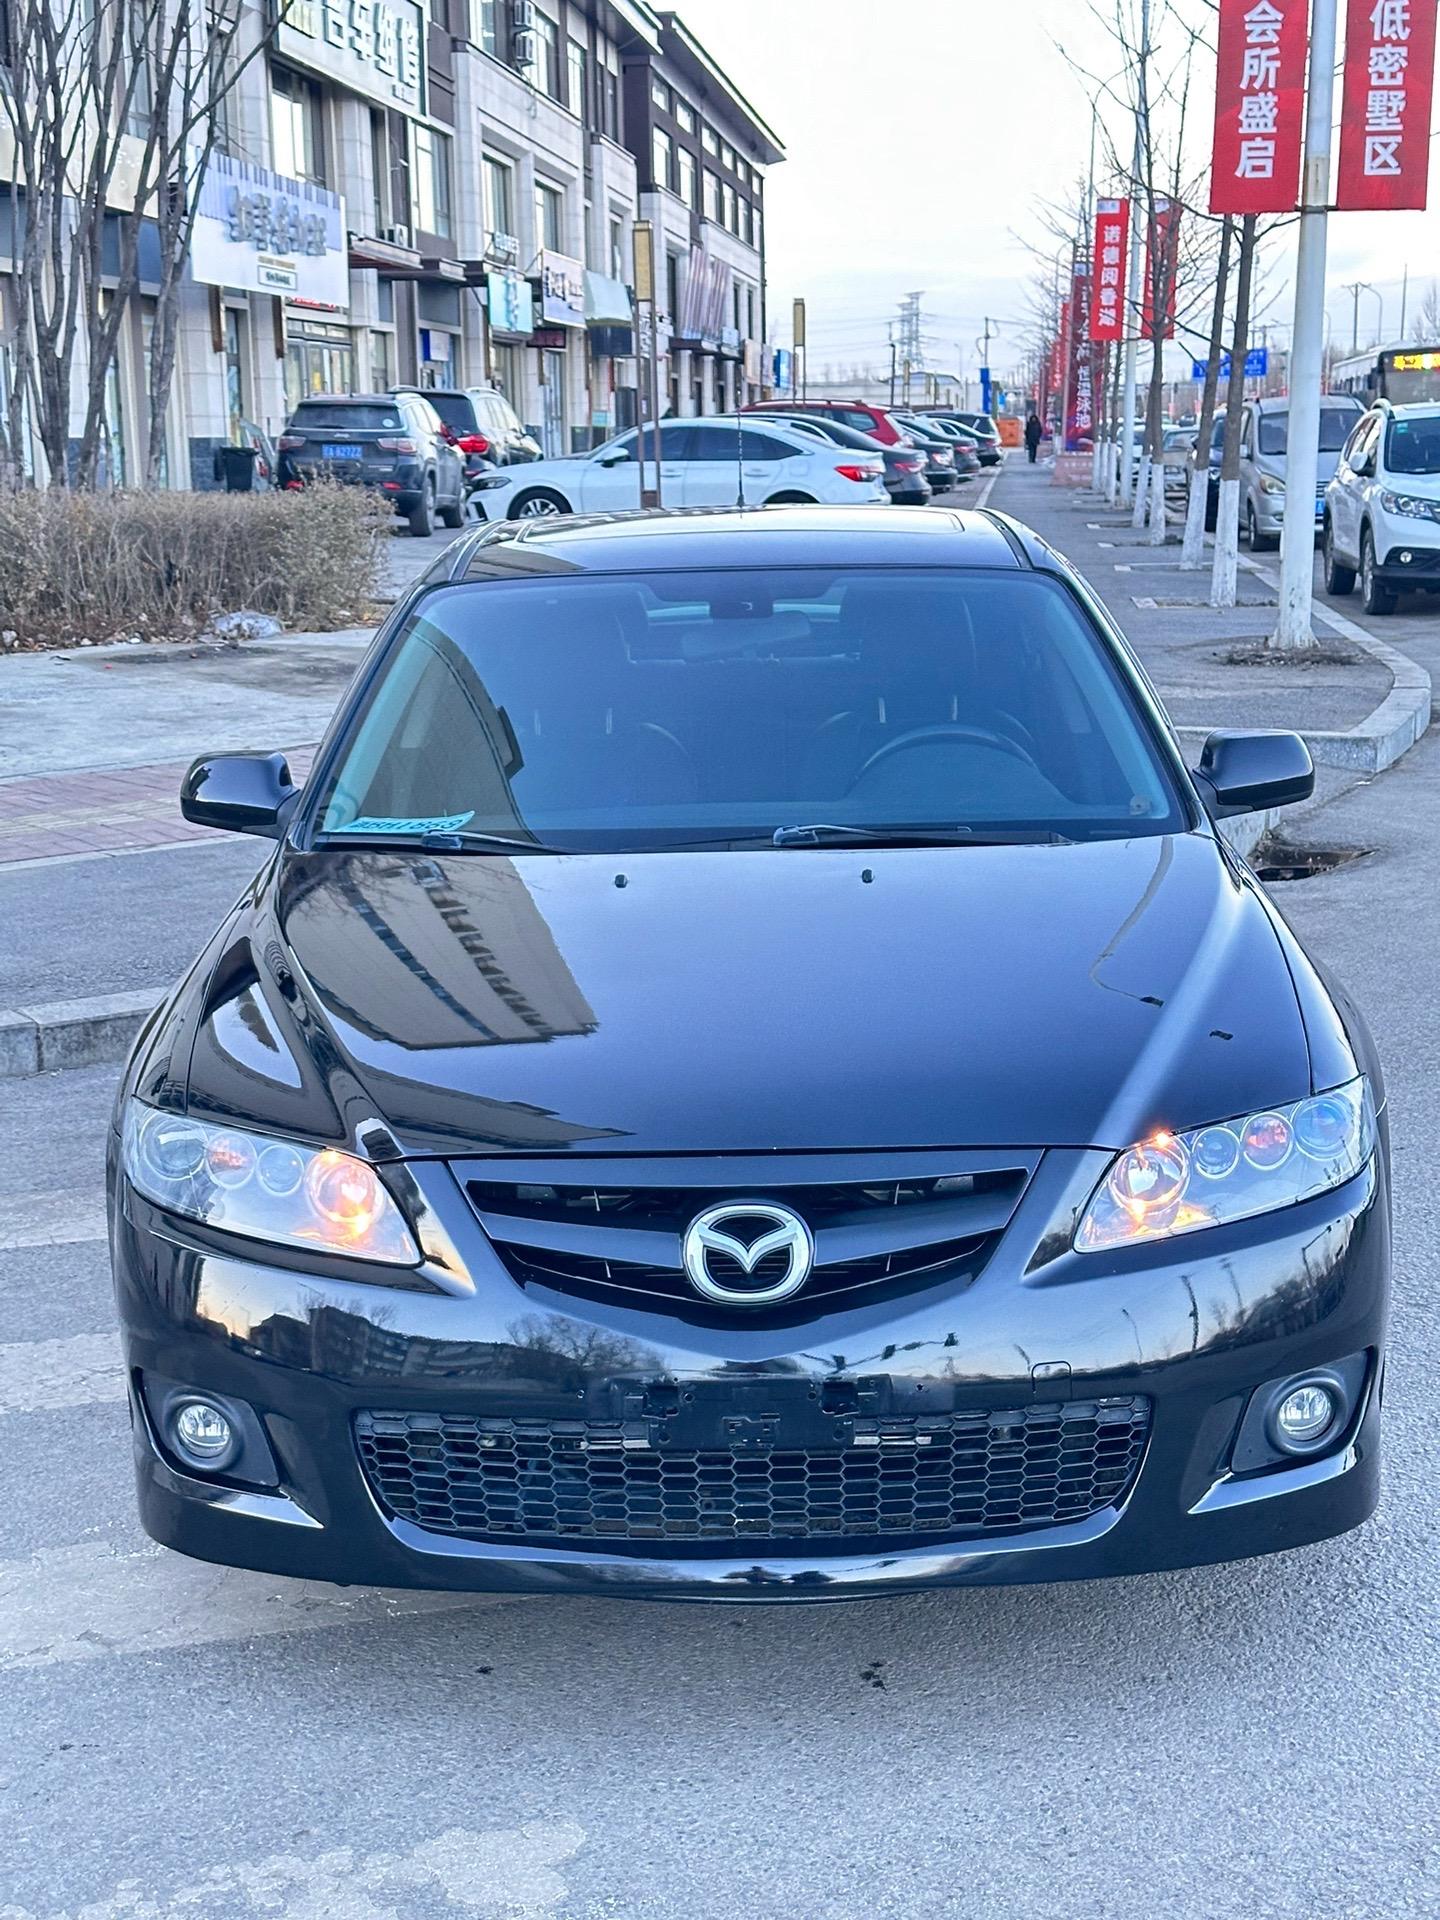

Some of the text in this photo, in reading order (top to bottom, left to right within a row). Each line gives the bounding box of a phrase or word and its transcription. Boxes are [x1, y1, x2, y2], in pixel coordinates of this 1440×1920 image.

[1234, 0, 1284, 178] 会所盛启
[1364, 0, 1411, 176] 低密墅区
